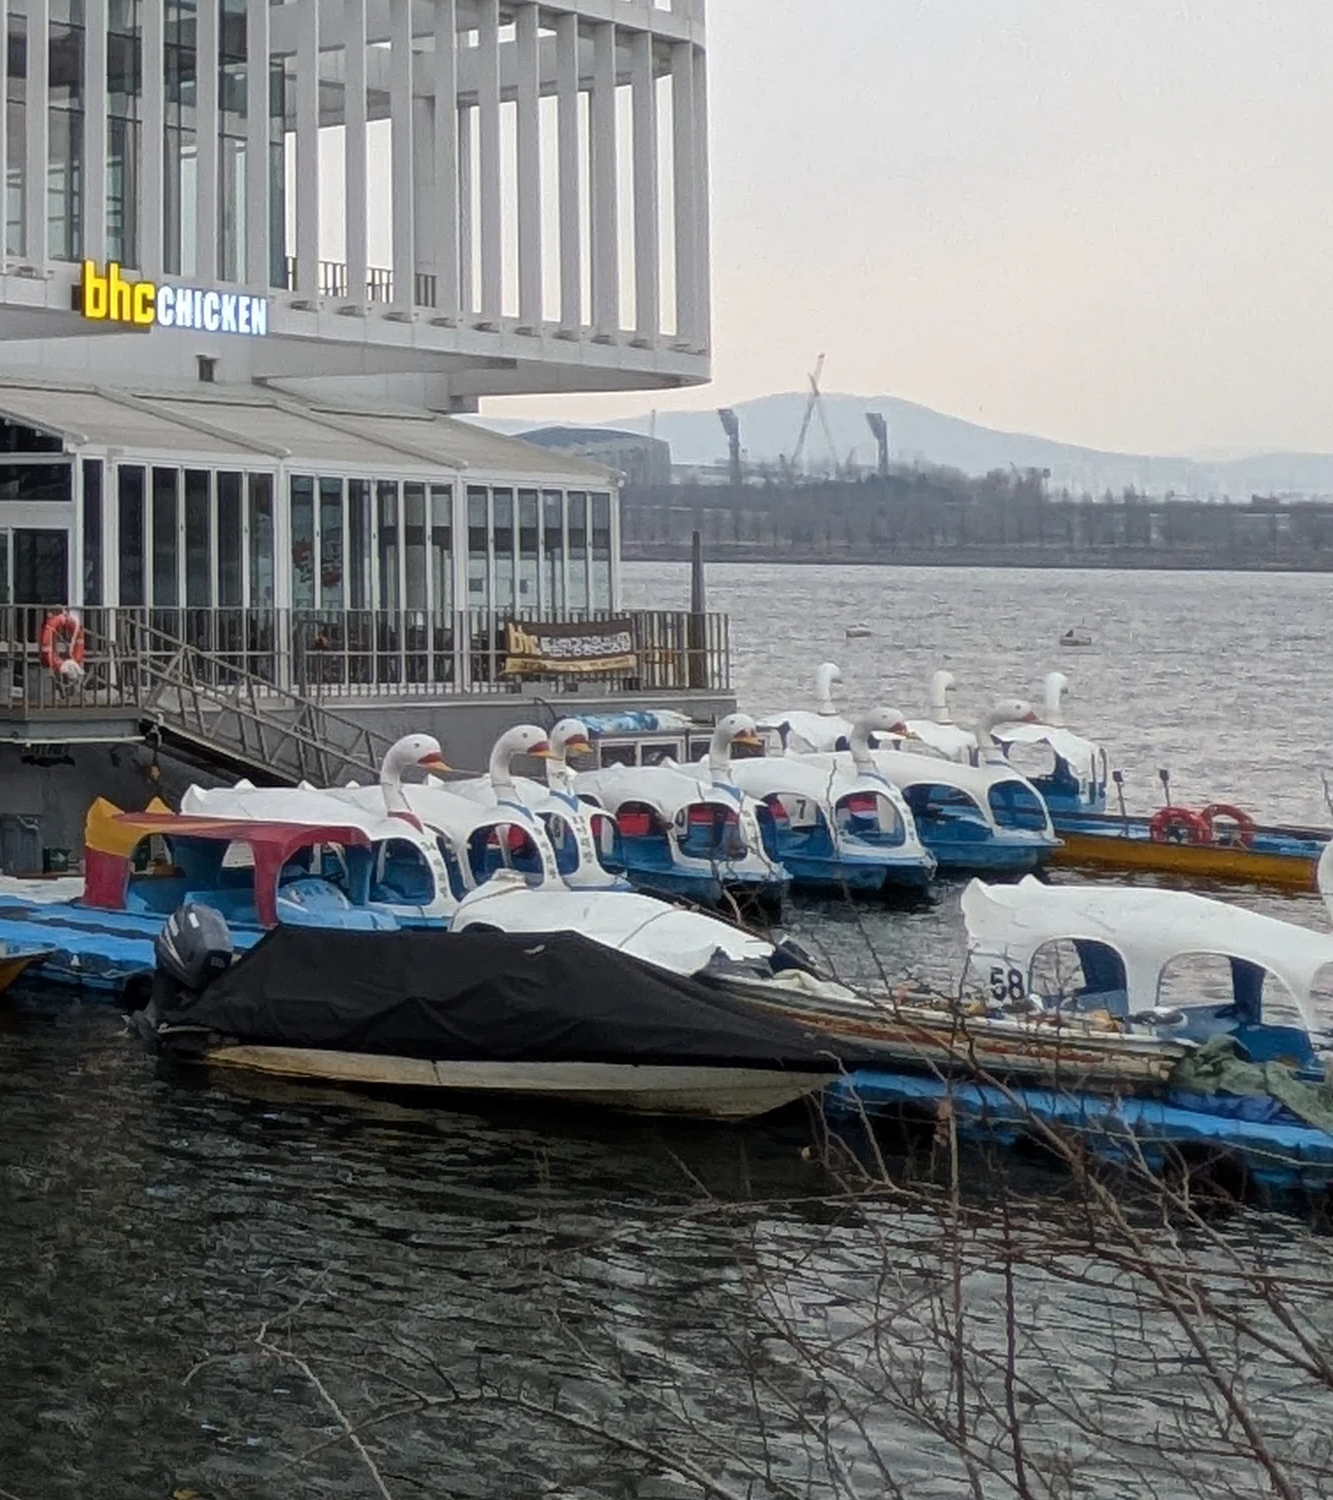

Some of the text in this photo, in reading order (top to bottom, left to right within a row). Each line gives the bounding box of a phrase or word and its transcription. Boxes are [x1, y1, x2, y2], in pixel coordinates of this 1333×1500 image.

[84, 258, 267, 336] bhc CHICKEN
[990, 966, 1025, 1001] 58
